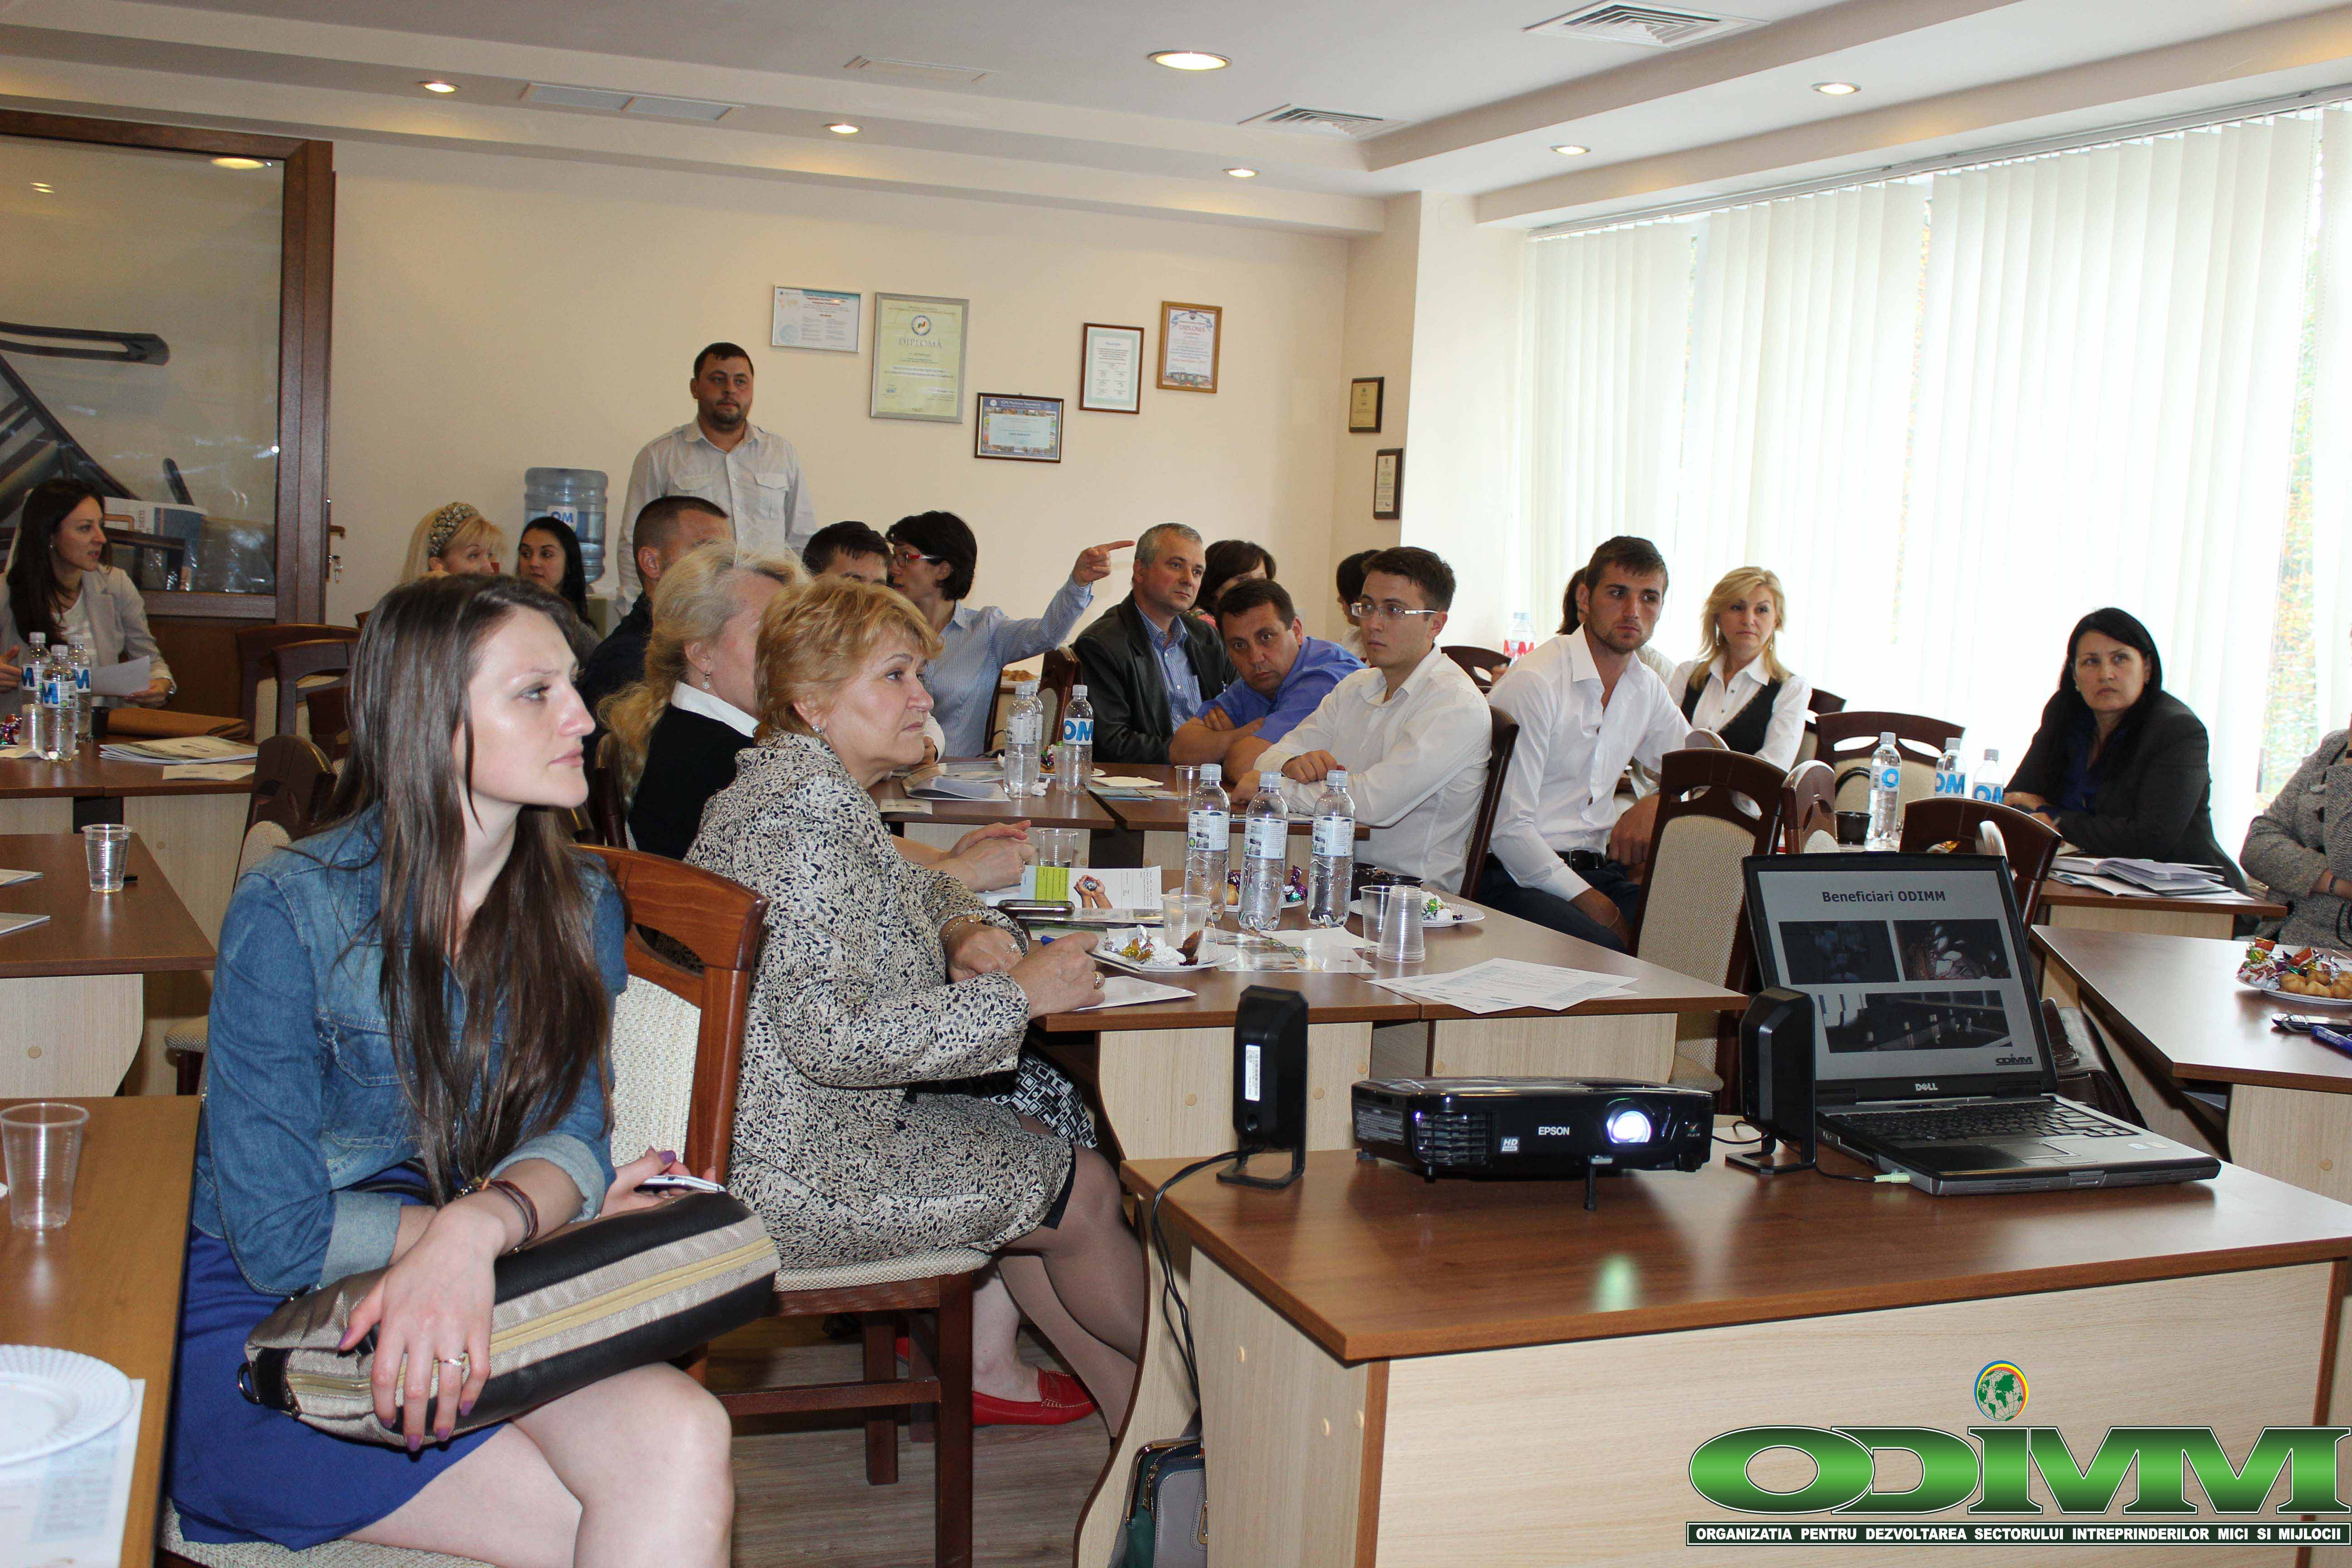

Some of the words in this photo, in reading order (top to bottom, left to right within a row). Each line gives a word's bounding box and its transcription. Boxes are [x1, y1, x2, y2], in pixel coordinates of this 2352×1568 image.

[1063, 720, 1093, 741] OM
[1822, 891, 1894, 902] Beneficiari
[1898, 891, 1946, 902] ODIMM
[1915, 1083, 1938, 1091] DELL
[1538, 1127, 1570, 1135] EPSON
